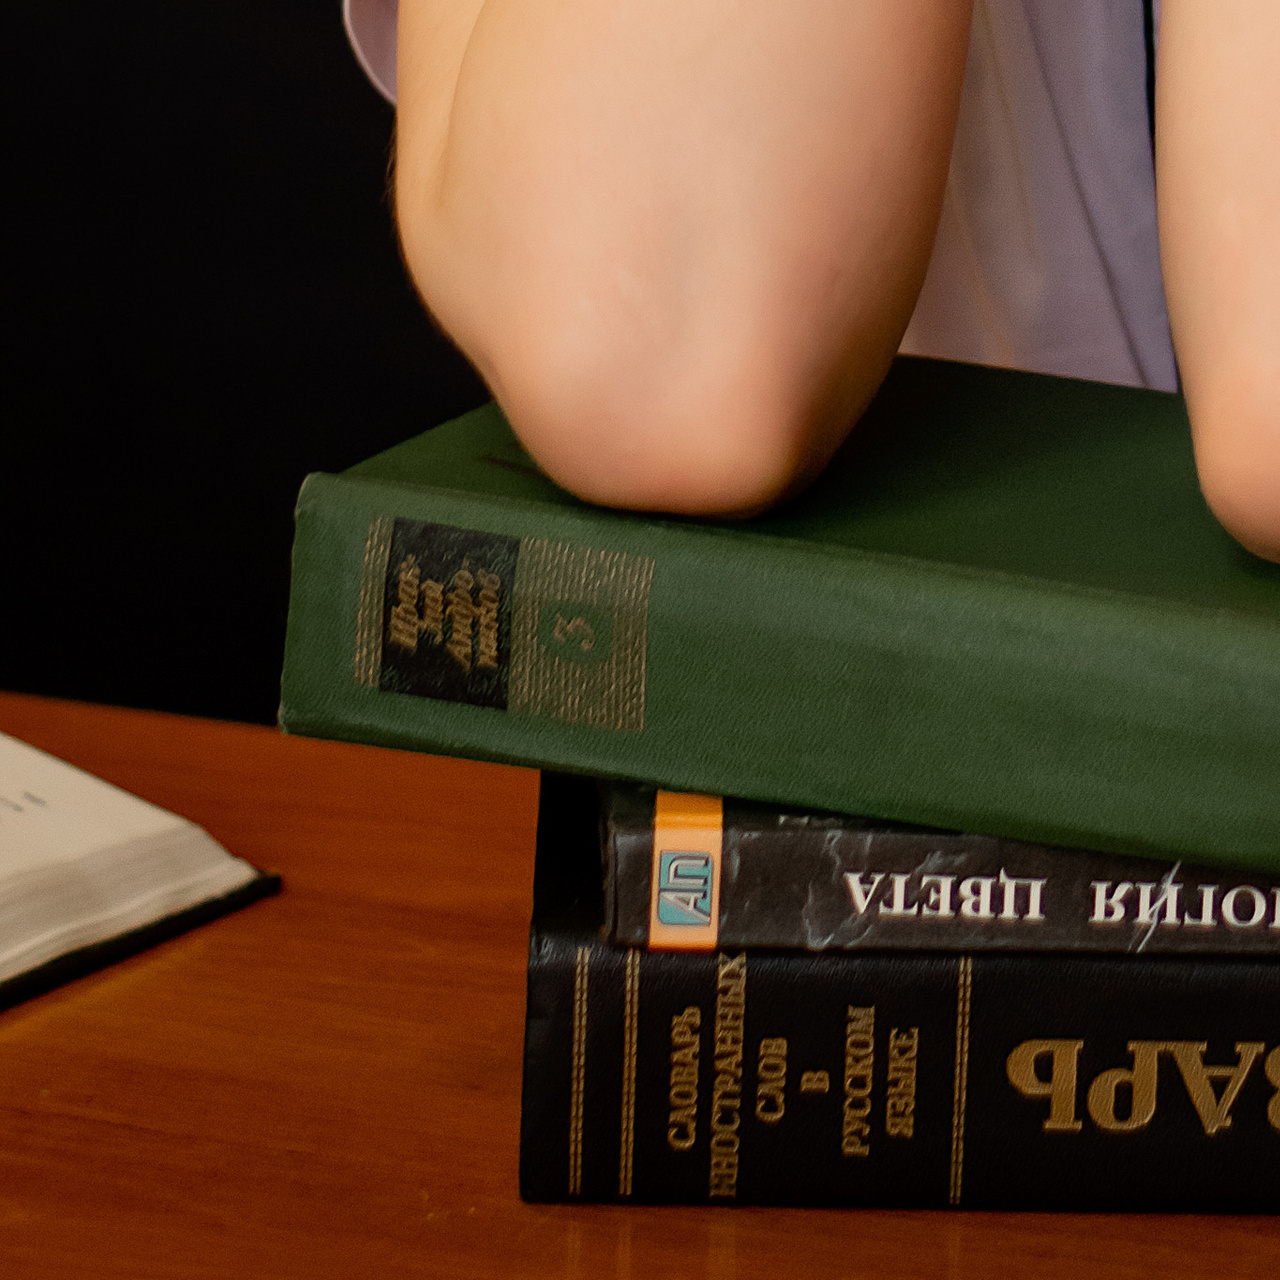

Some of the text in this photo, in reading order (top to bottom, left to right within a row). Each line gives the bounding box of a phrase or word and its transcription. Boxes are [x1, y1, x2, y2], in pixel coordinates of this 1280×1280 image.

[553, 613, 596, 651] 3
[843, 867, 1048, 922] ЦВЕТА
[667, 1005, 701, 1153] СЛОВАРЬ
[709, 950, 747, 1199] ИНОСТРАННЫХ
[755, 1037, 788, 1124] СЛОВ
[800, 1069, 830, 1094] В
[841, 1004, 876, 1158] РУССКОМ
[885, 1026, 919, 1139] ЯЗЫКЕ
